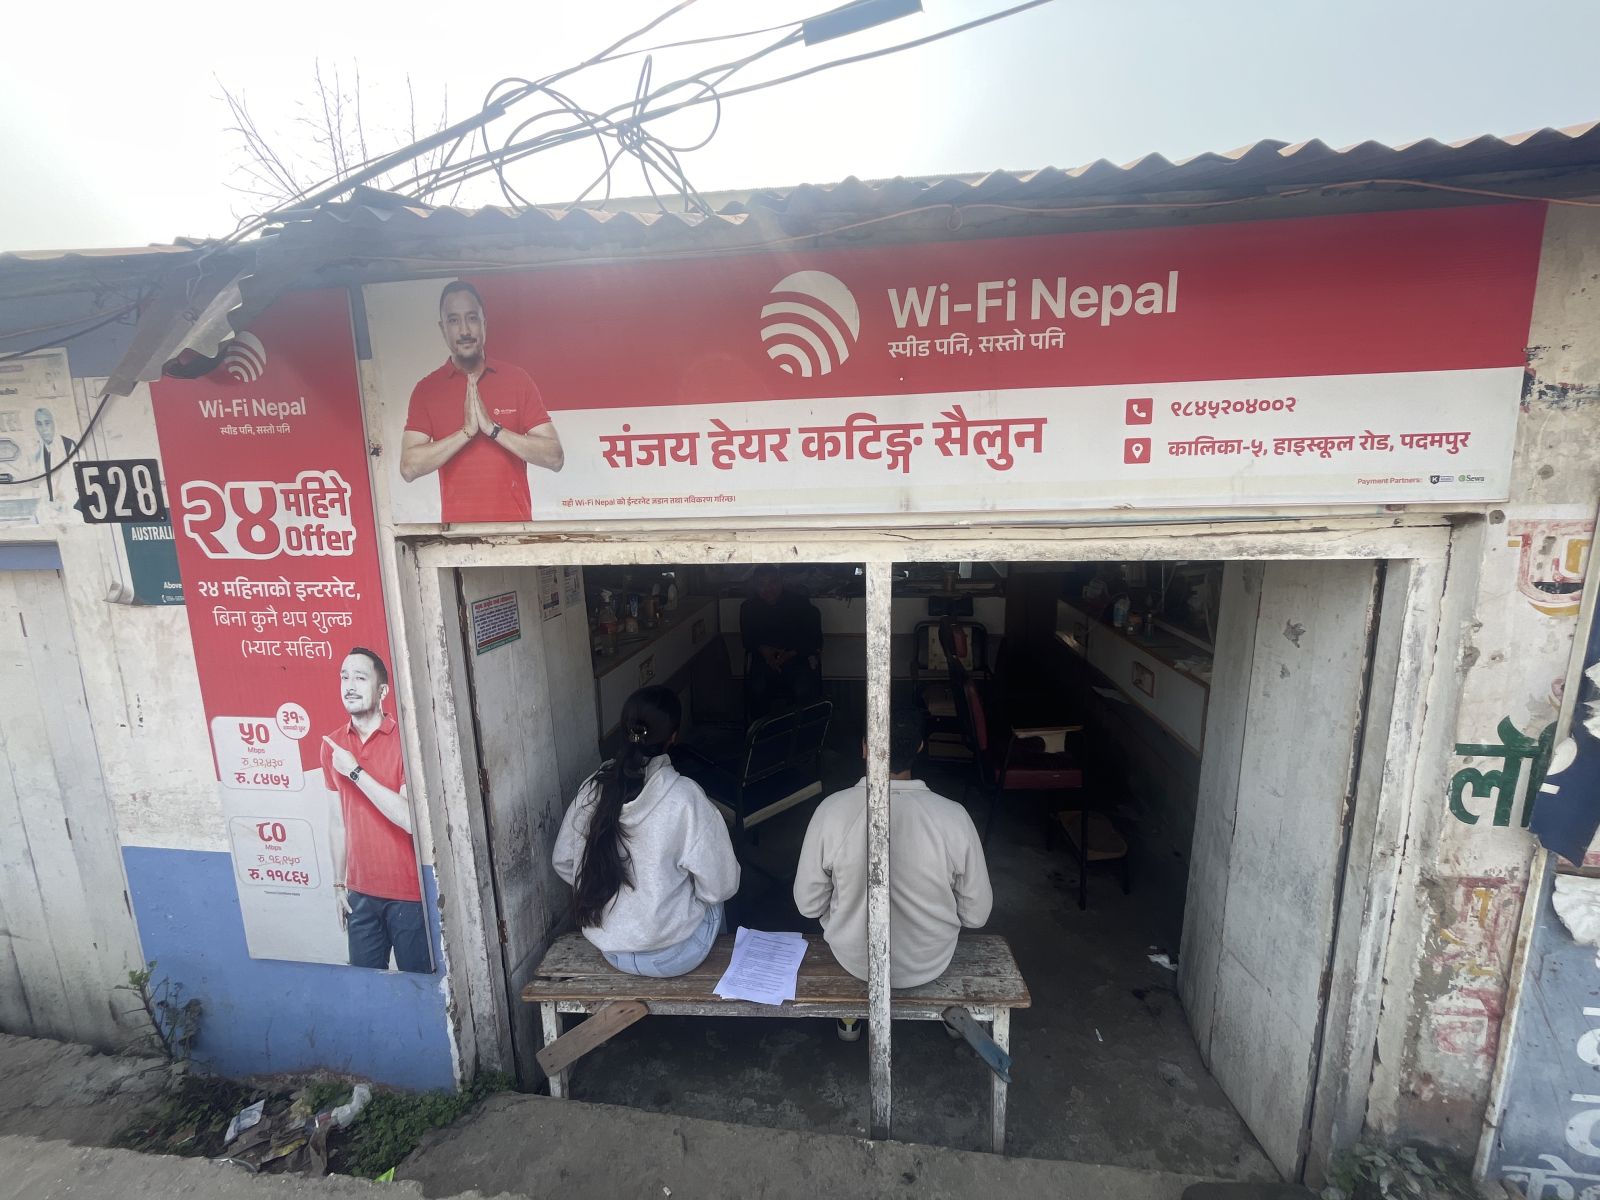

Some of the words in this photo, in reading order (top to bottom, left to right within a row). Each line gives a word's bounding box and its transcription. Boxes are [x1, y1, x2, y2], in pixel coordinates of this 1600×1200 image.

[888, 278, 1017, 328] Wi-Fi
[1031, 271, 1178, 326] Nepal
[888, 335, 930, 358] स्पीड
[935, 333, 973, 356] पनि,
[978, 329, 1025, 353] सस्तो
[1029, 327, 1065, 350] पनि
[199, 399, 249, 418] Wi-Fi
[251, 397, 306, 420] Nepal
[1170, 397, 1297, 419] ९८४५२०४००२
[220, 424, 238, 435] स्पीड
[256, 423, 275, 434] सस्तो
[277, 422, 291, 434] पनि
[599, 424, 700, 468] संजय
[707, 419, 791, 470] हेयर
[932, 404, 1047, 471] सैलुन
[1168, 435, 1268, 457] कालिका-५,
[1273, 434, 1355, 458] हाइस्कूल
[1359, 430, 1394, 452] रोड,
[1400, 431, 1471, 454] पदमपुर
[82, 464, 158, 520] 528
[1357, 477, 1389, 485] Payment
[575, 498, 593, 506] Wi-Fi
[595, 498, 615, 507] Nepal
[184, 484, 282, 556] २४
[279, 475, 348, 519] महिने
[131, 526, 175, 541] AUSTRALI
[286, 523, 353, 551] Offer
[198, 581, 219, 597] २४
[222, 576, 291, 600] महिनाको
[212, 605, 247, 627] बिना
[249, 605, 278, 633] कुनै
[282, 610, 307, 627] थप
[311, 611, 353, 634] शुल्क
[241, 639, 282, 658] (भ्याट
[283, 636, 333, 660] सहित)
[239, 722, 270, 746] ५०
[247, 746, 266, 754] Mbps
[256, 821, 287, 843] ८०
